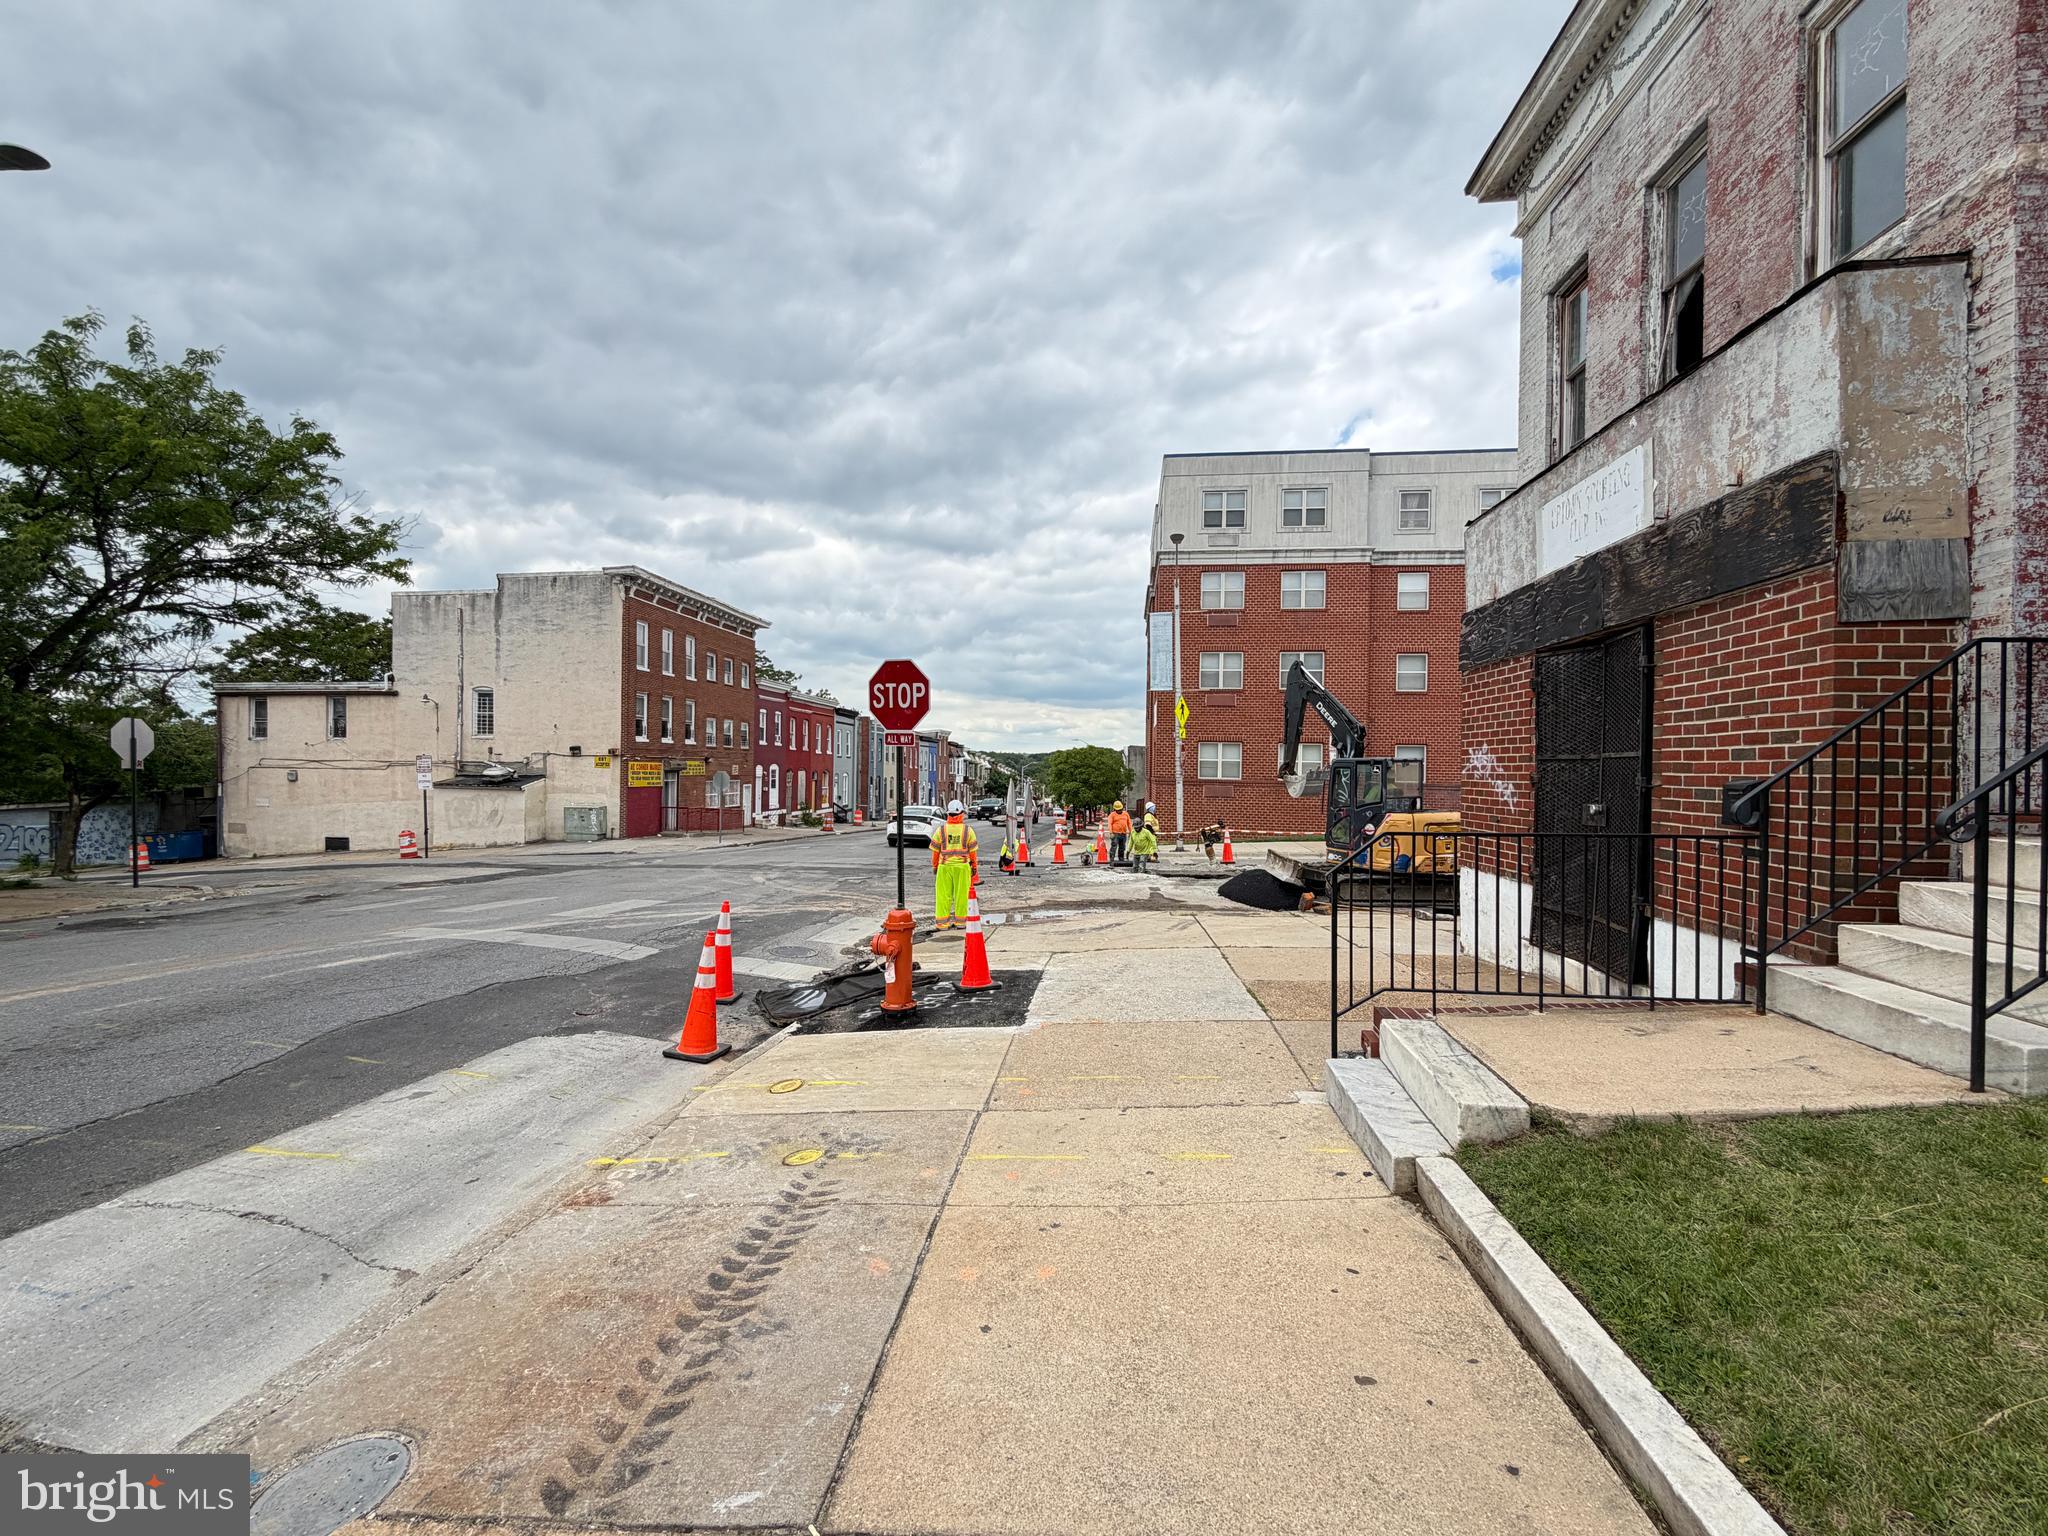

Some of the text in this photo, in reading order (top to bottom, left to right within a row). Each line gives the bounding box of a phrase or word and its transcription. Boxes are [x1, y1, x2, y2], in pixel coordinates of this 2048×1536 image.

[873, 682, 926, 709] STOP
[1315, 701, 1338, 728] DEERE
[887, 735, 912, 744] ALL WAY
